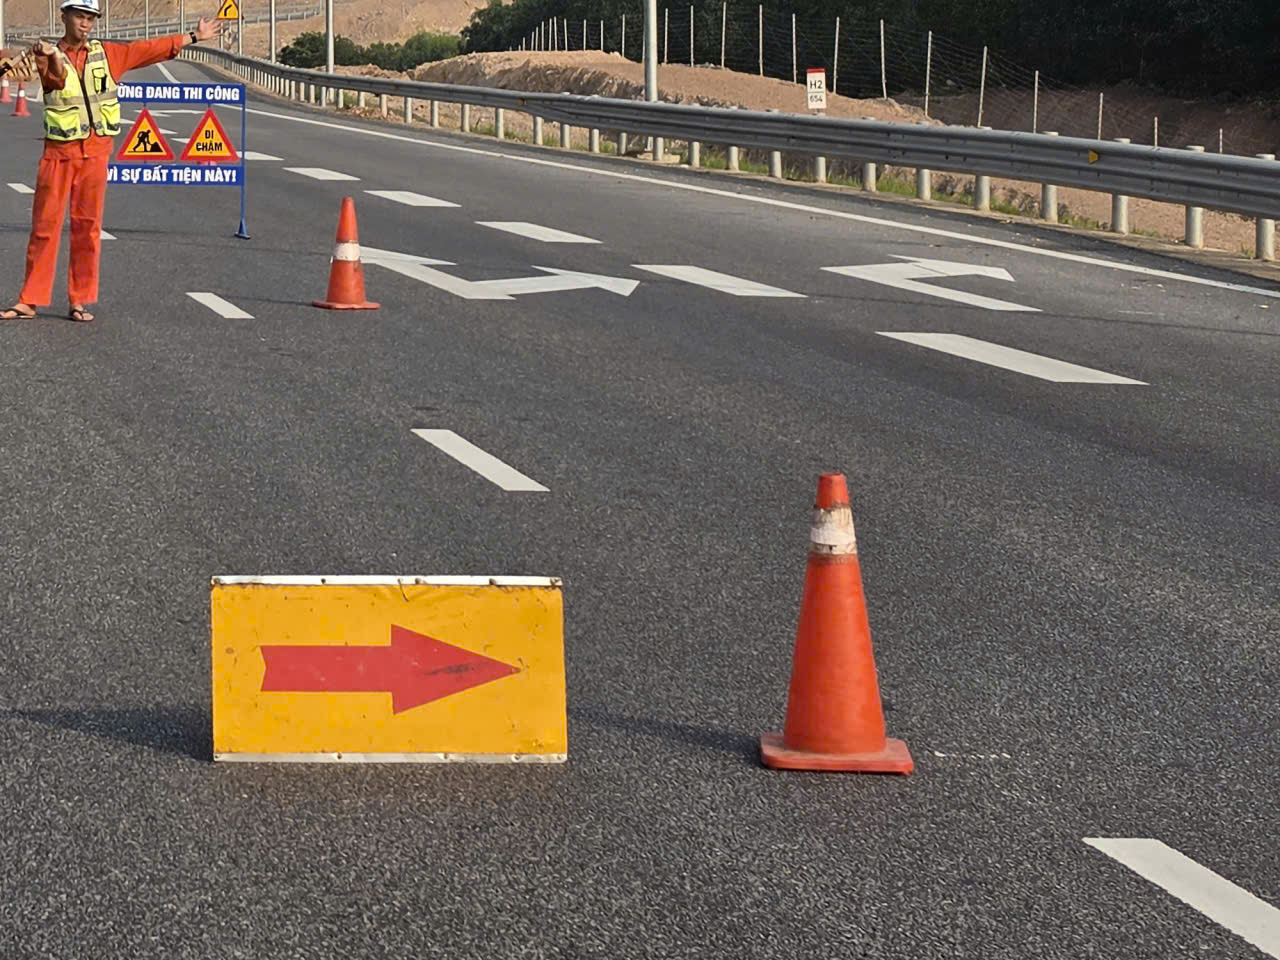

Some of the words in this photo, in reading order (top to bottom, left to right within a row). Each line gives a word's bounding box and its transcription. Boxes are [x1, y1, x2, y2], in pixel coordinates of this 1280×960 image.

[117, 82, 143, 99] ỜNG
[146, 86, 180, 99] ĐANG
[183, 87, 203, 100] THI
[205, 85, 240, 100] CÔNG
[809, 79, 823, 89] H2
[195, 140, 223, 155] CHẬM
[121, 167, 142, 184] SỰ
[143, 165, 168, 182] BẤT
[171, 167, 202, 184] TIỆN
[204, 167, 237, 183] NÀY!
